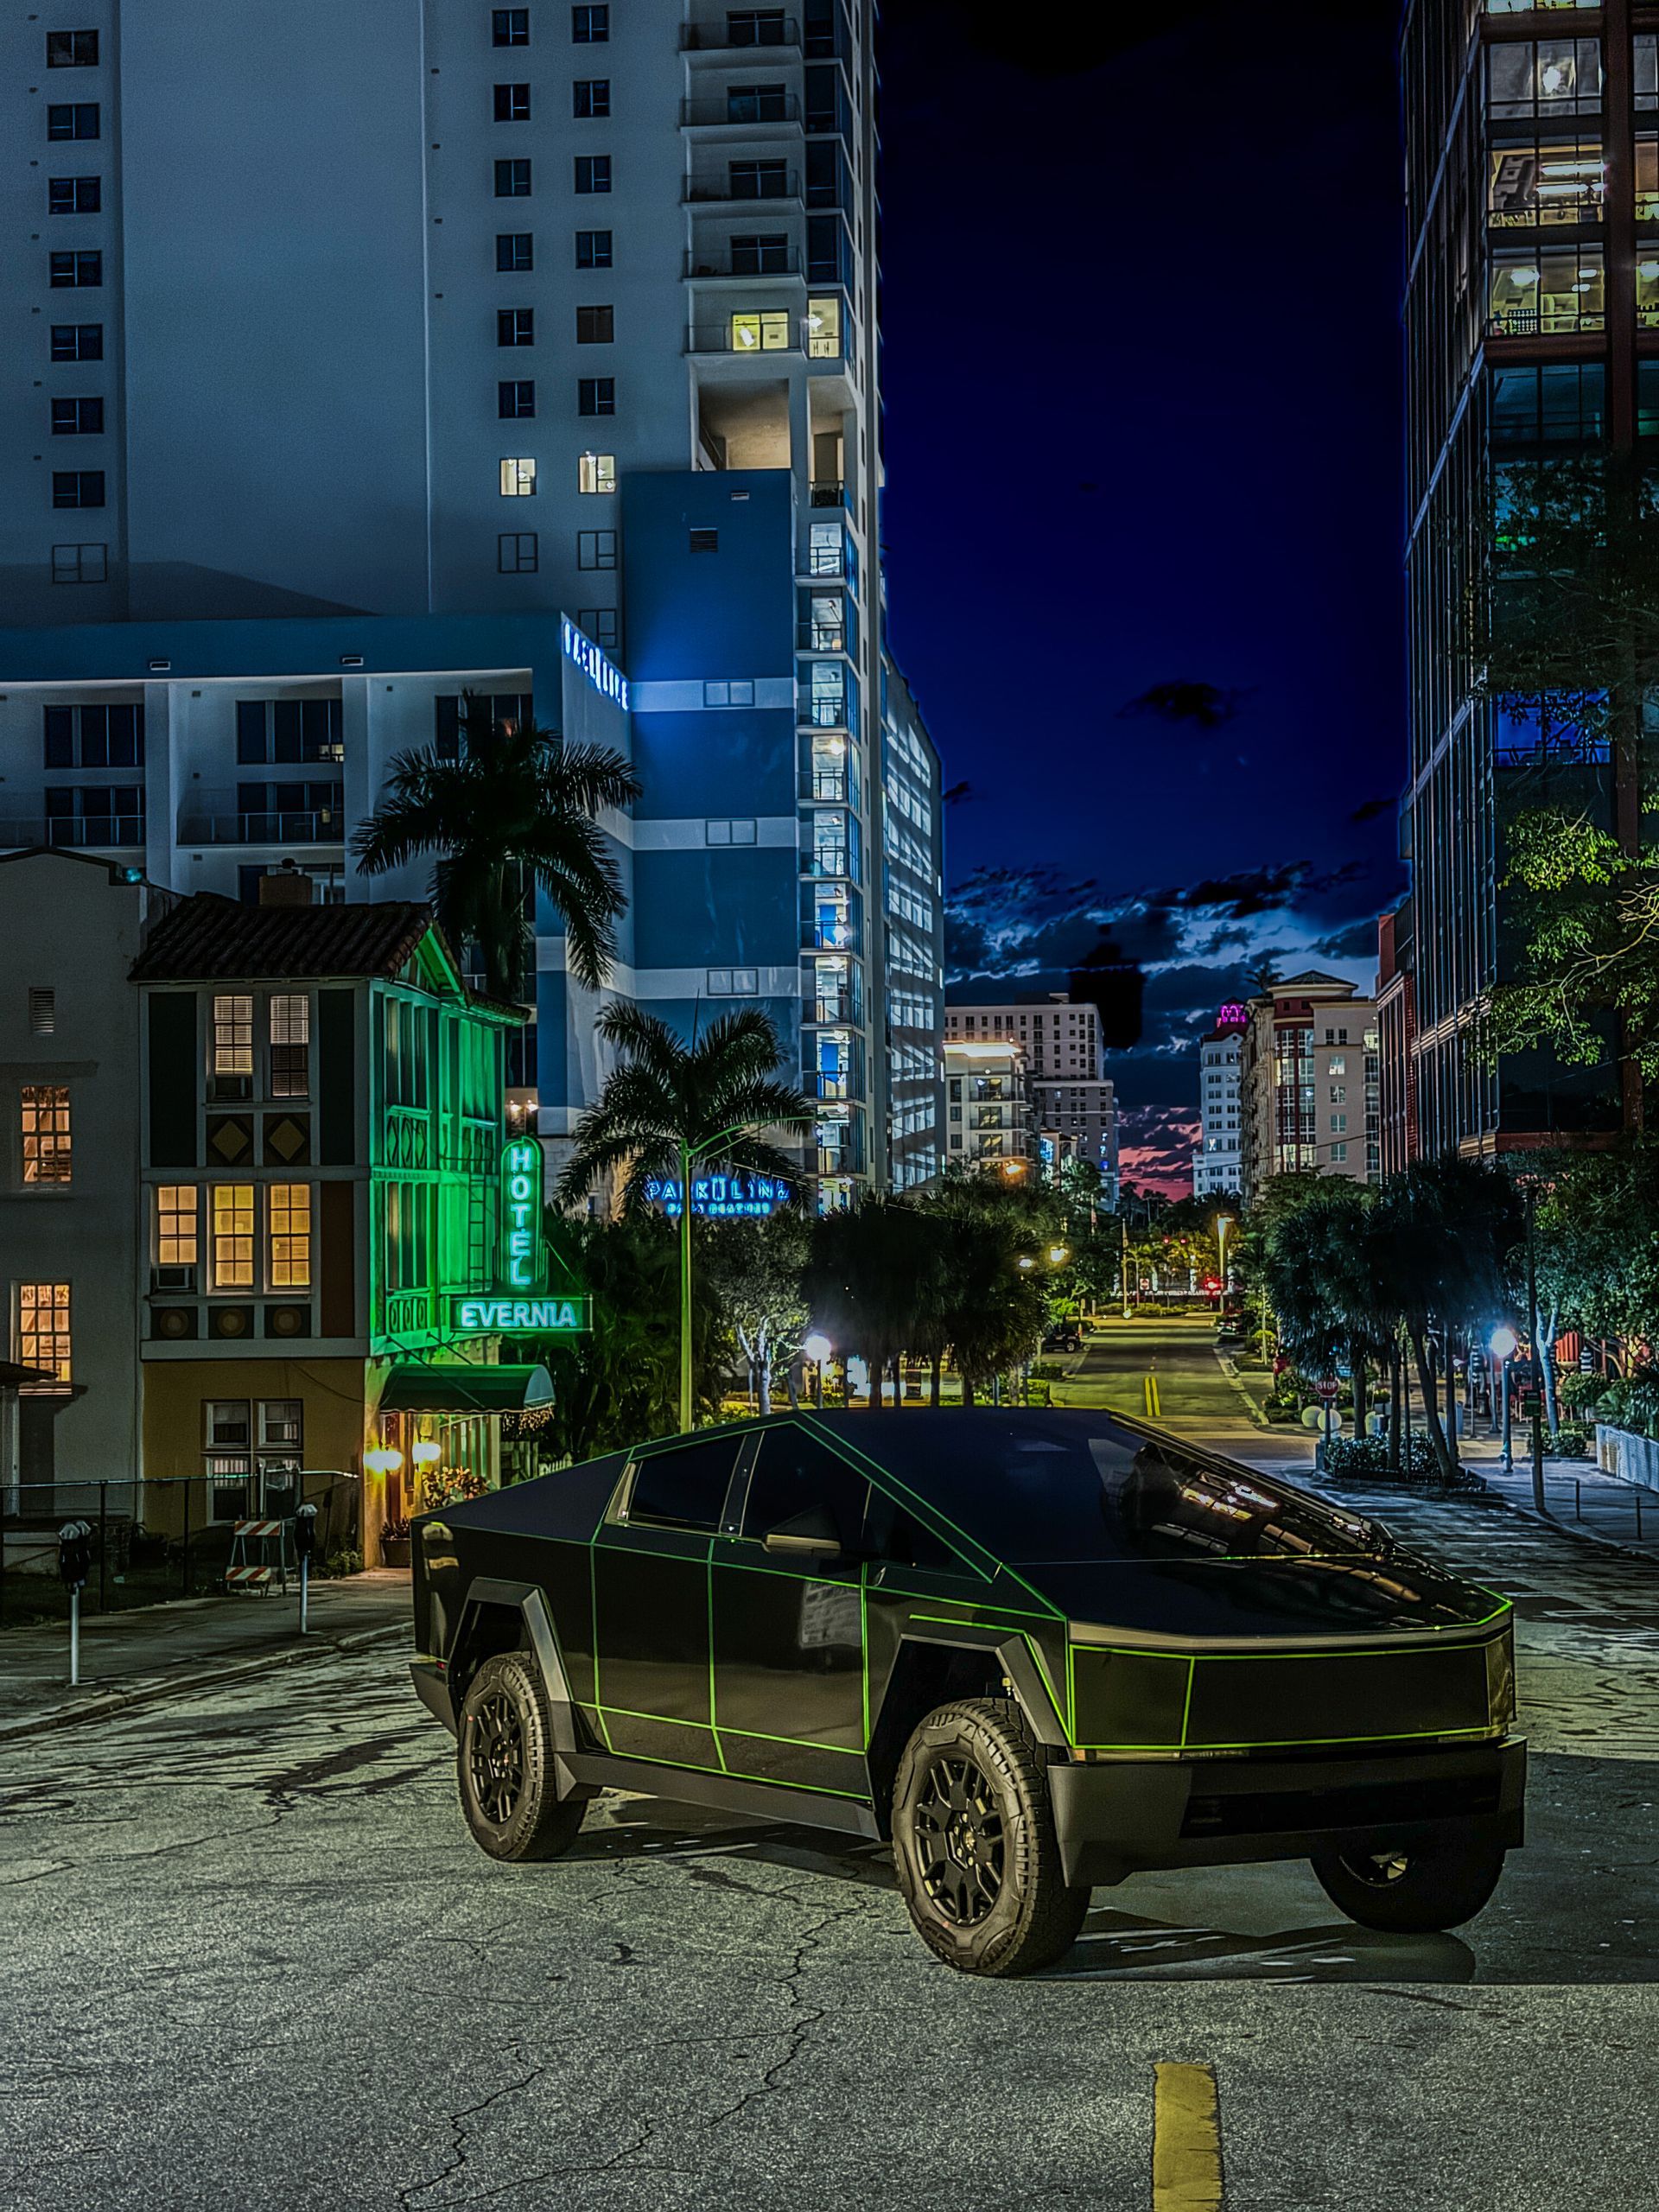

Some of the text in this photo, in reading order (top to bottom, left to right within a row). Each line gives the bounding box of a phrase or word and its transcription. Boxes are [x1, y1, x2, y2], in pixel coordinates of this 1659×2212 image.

[510, 1147, 532, 1286] HOTEL
[461, 1301, 577, 1328] EVERNIA
[1317, 1381, 1338, 1390] STOP
